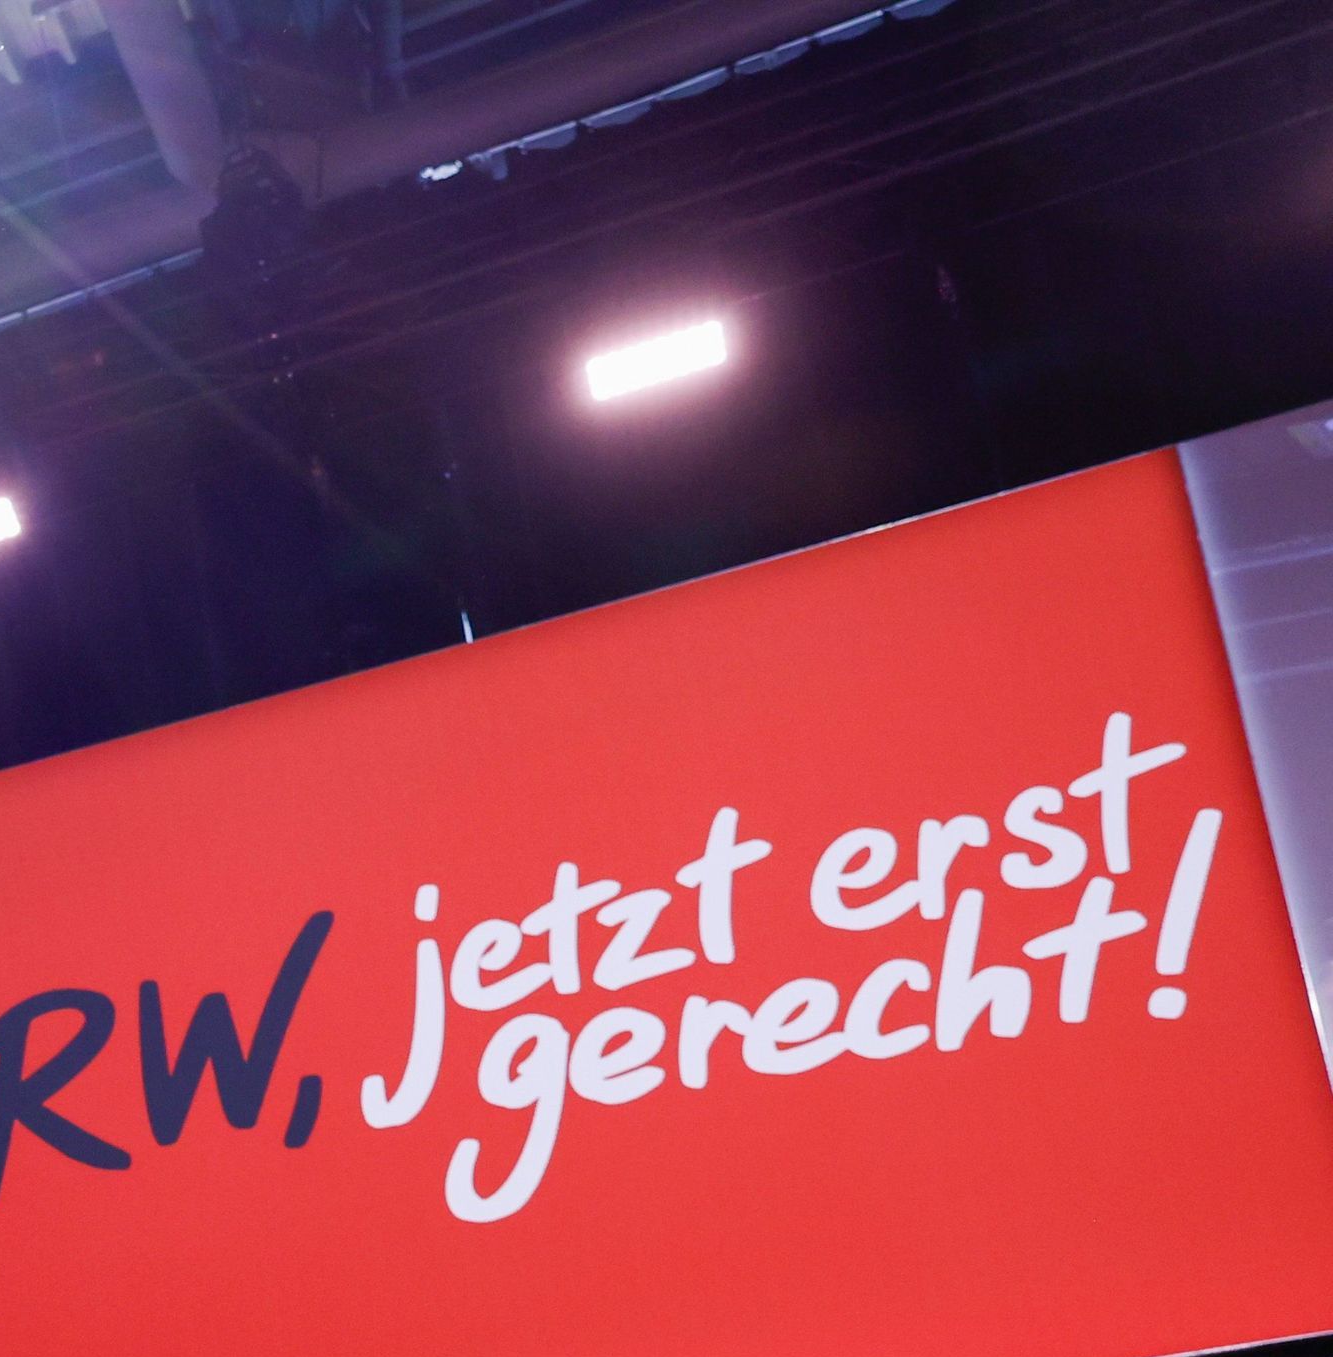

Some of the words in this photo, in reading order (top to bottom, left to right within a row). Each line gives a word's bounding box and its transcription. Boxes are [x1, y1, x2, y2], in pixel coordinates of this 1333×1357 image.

[360, 806, 773, 1130] jetzt
[809, 711, 1187, 931] erst
[444, 808, 1223, 1224] gerecht!
